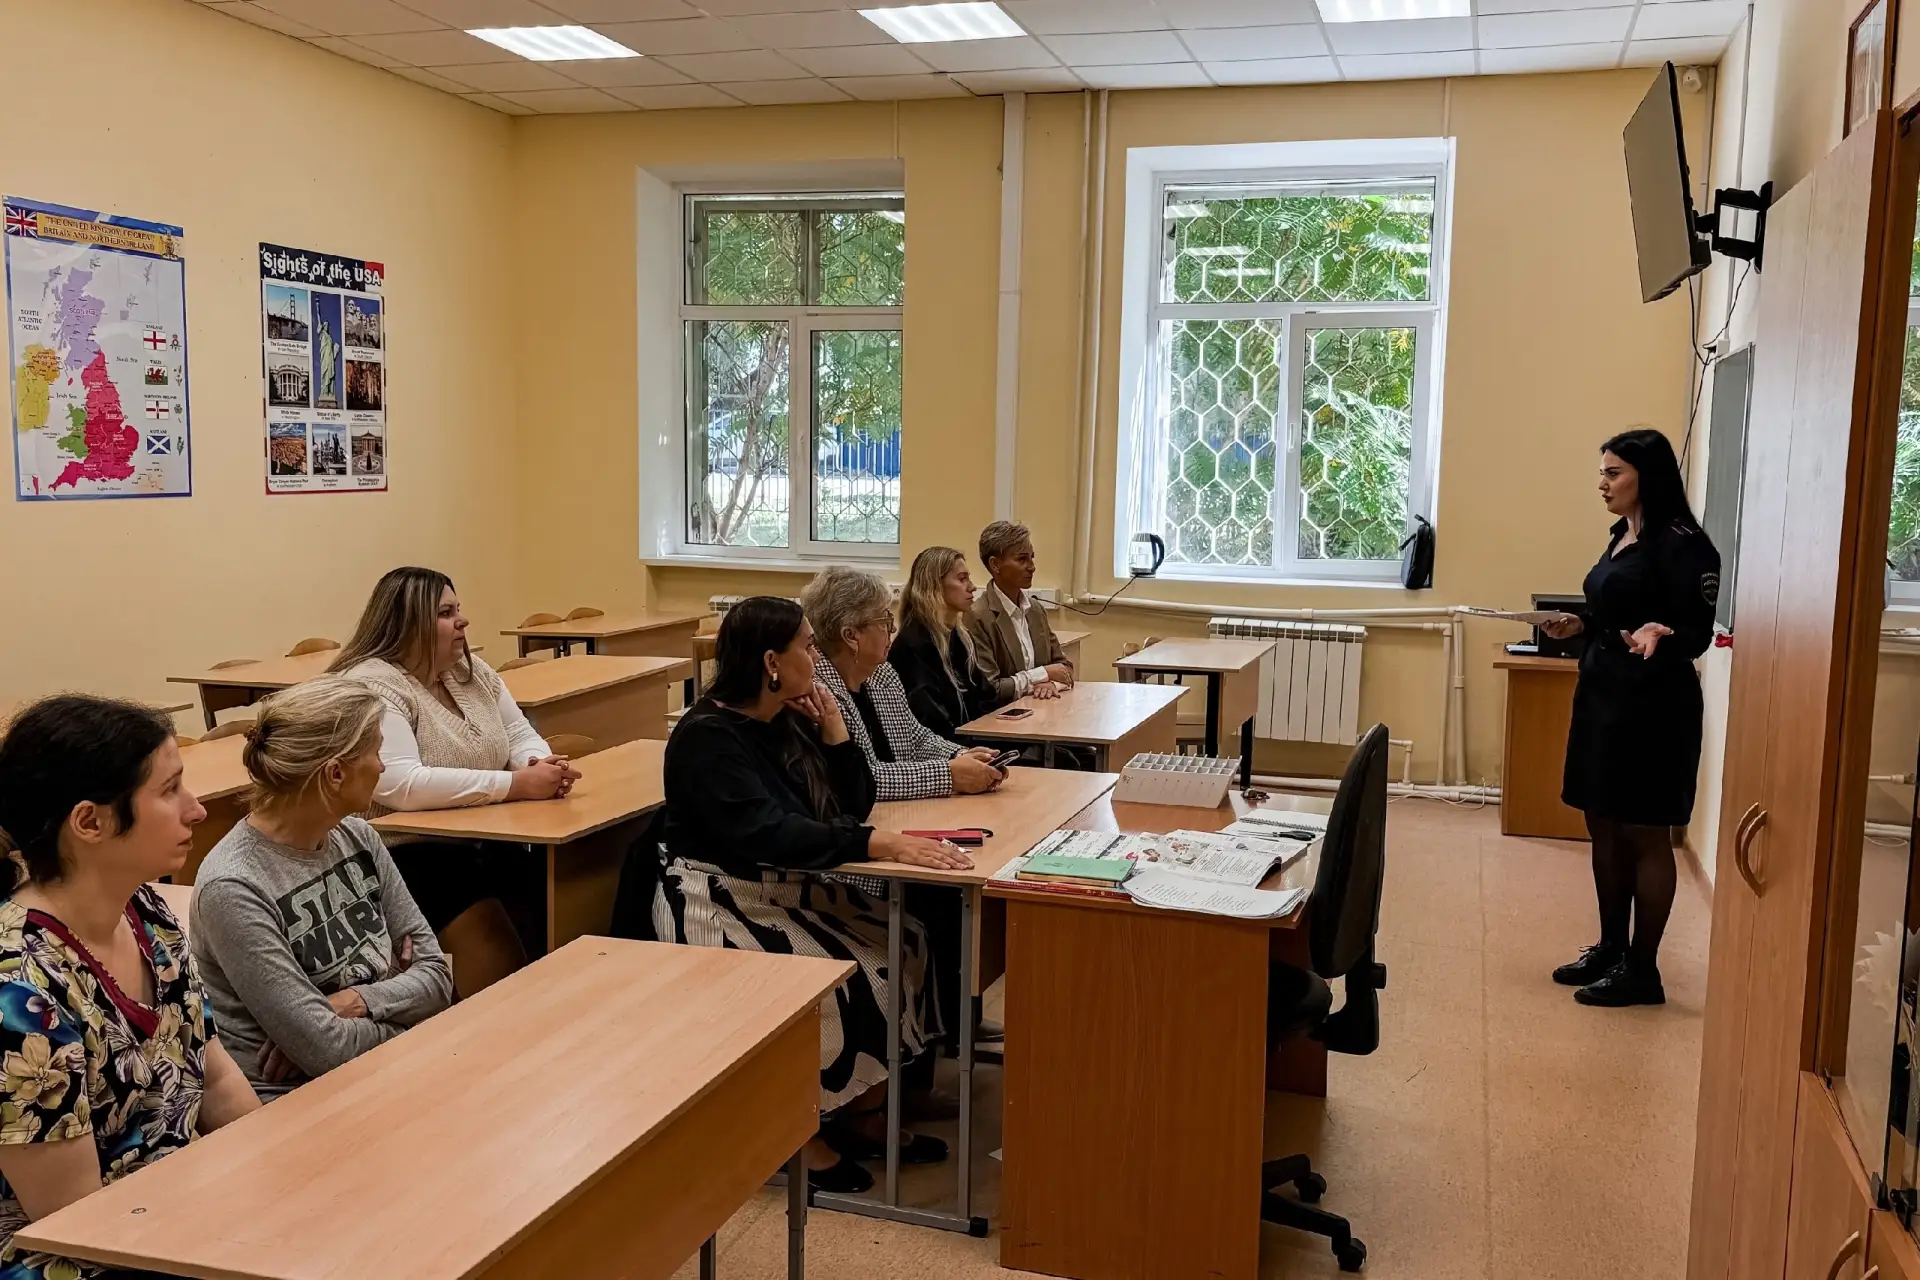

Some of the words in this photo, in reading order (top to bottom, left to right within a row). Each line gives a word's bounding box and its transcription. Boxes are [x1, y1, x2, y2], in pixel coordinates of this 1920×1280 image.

[46, 216, 61, 226] THE
[63, 218, 89, 231] UNITED
[73, 231, 88, 241] AND
[89, 235, 127, 246] NORTHERN
[127, 240, 155, 251] IRELAND
[263, 251, 309, 275] Sights
[312, 261, 326, 277] of
[329, 263, 351, 281] the
[354, 267, 382, 286] USA
[287, 861, 380, 941] STAR
